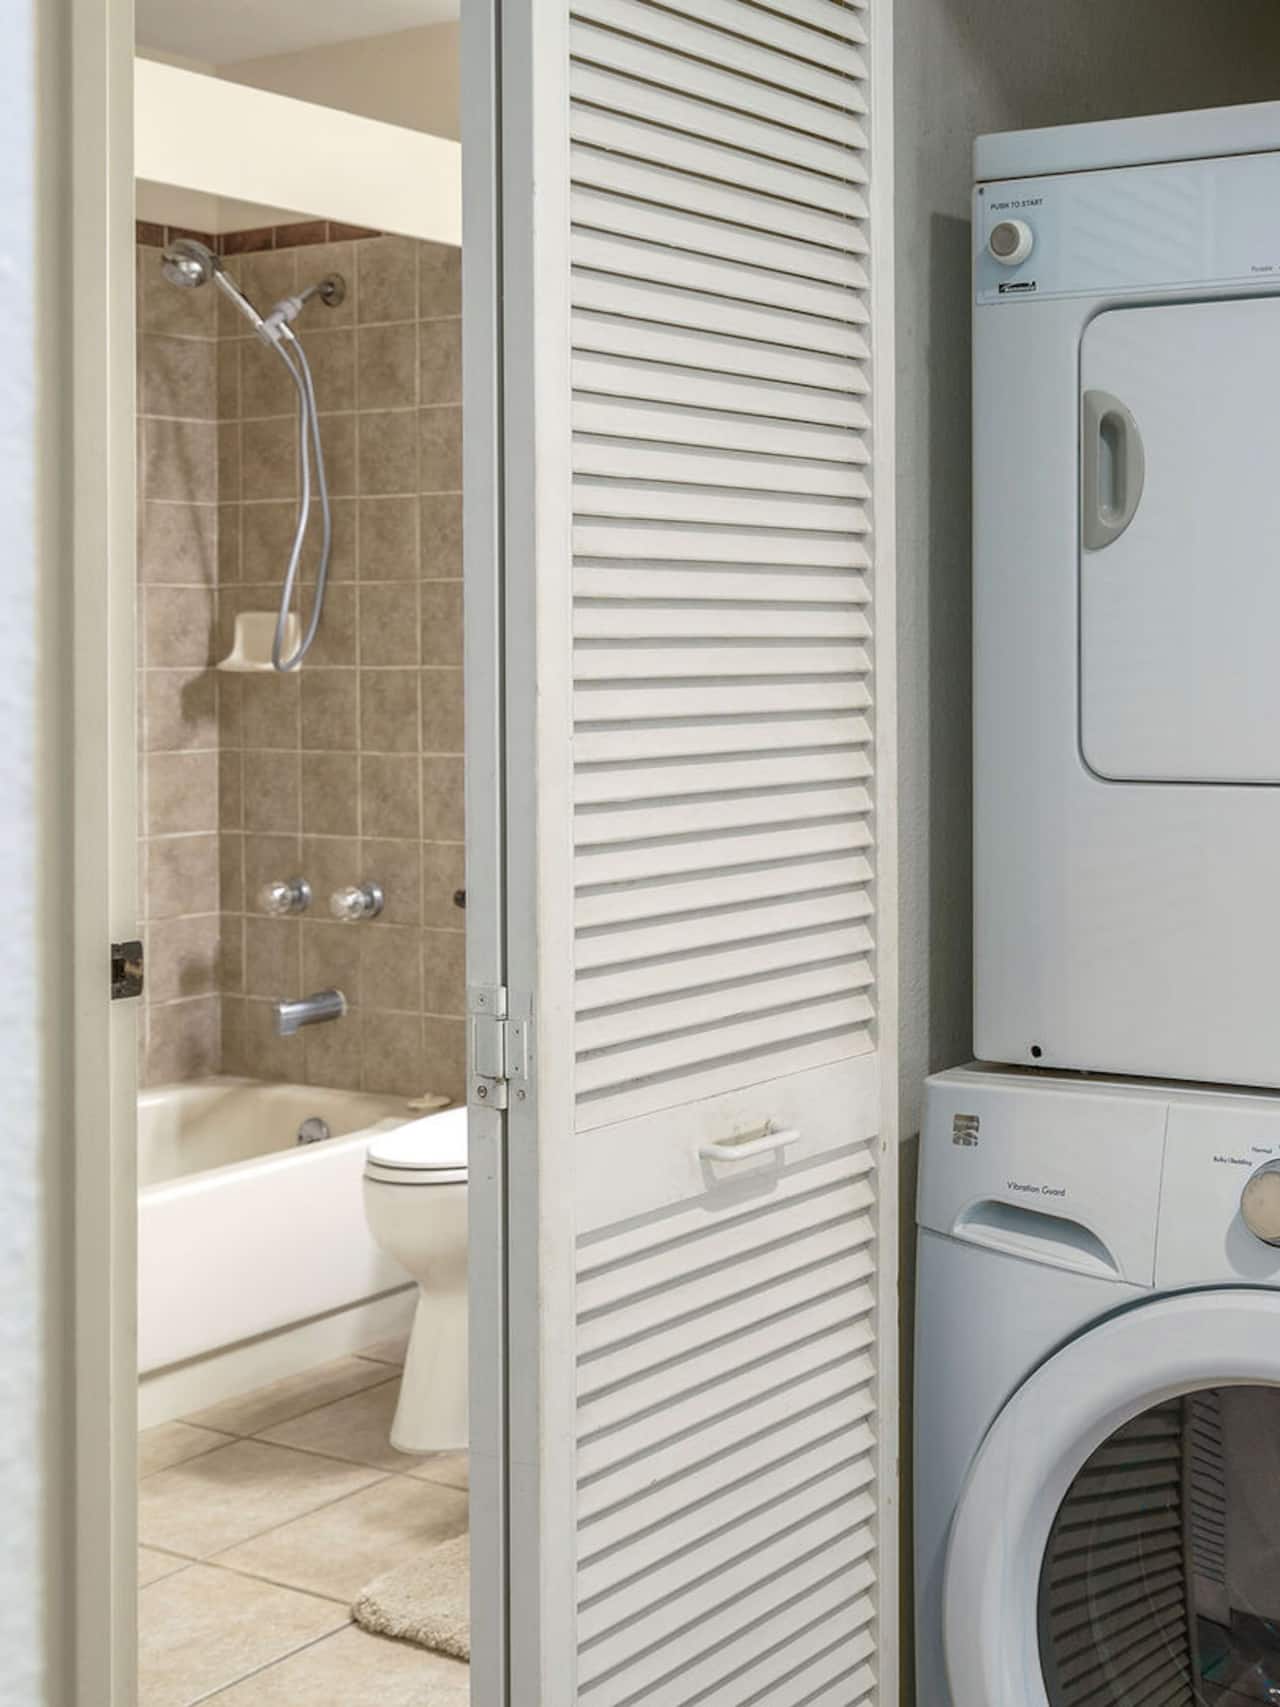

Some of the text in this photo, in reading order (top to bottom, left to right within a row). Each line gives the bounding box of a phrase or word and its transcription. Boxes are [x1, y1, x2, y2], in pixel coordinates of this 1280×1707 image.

[1022, 198, 1043, 207] START
[1007, 1182, 1066, 1197] Vibration Guard
